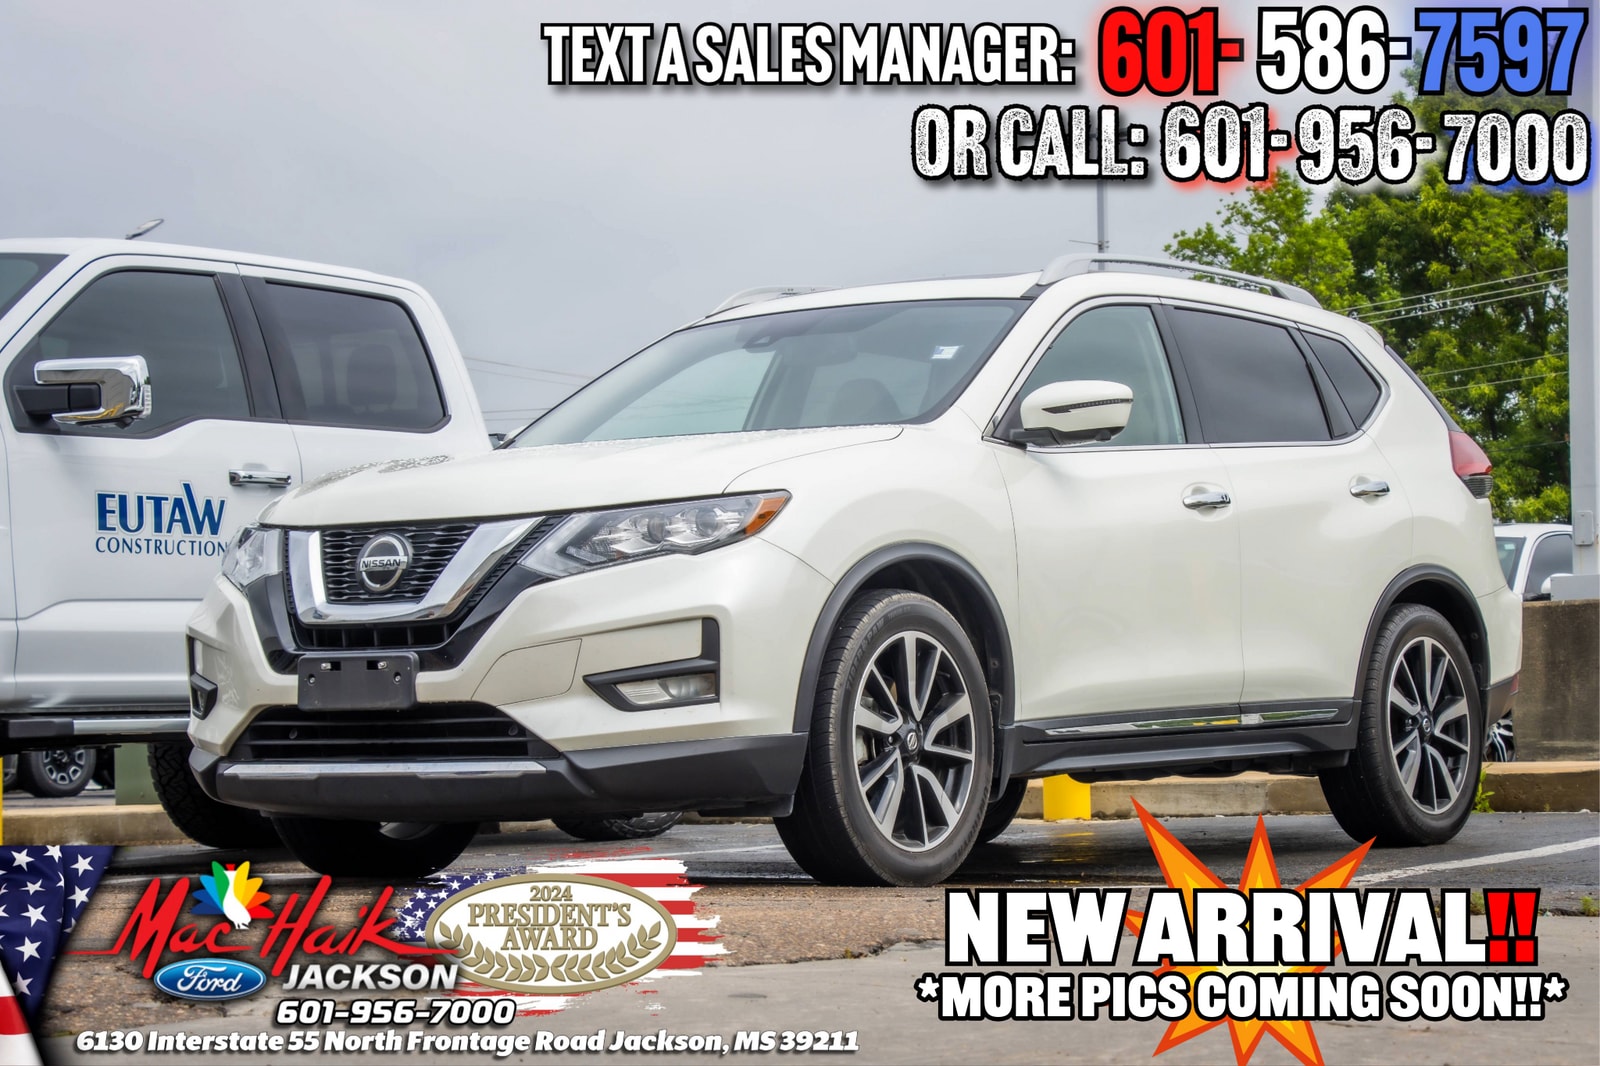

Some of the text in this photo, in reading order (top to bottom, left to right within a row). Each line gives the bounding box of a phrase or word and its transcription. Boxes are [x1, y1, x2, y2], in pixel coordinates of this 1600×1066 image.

[97, 483, 225, 535] EUTAW
[95, 537, 227, 557] CONSTRUCTION
[361, 558, 401, 569] NISSAN
